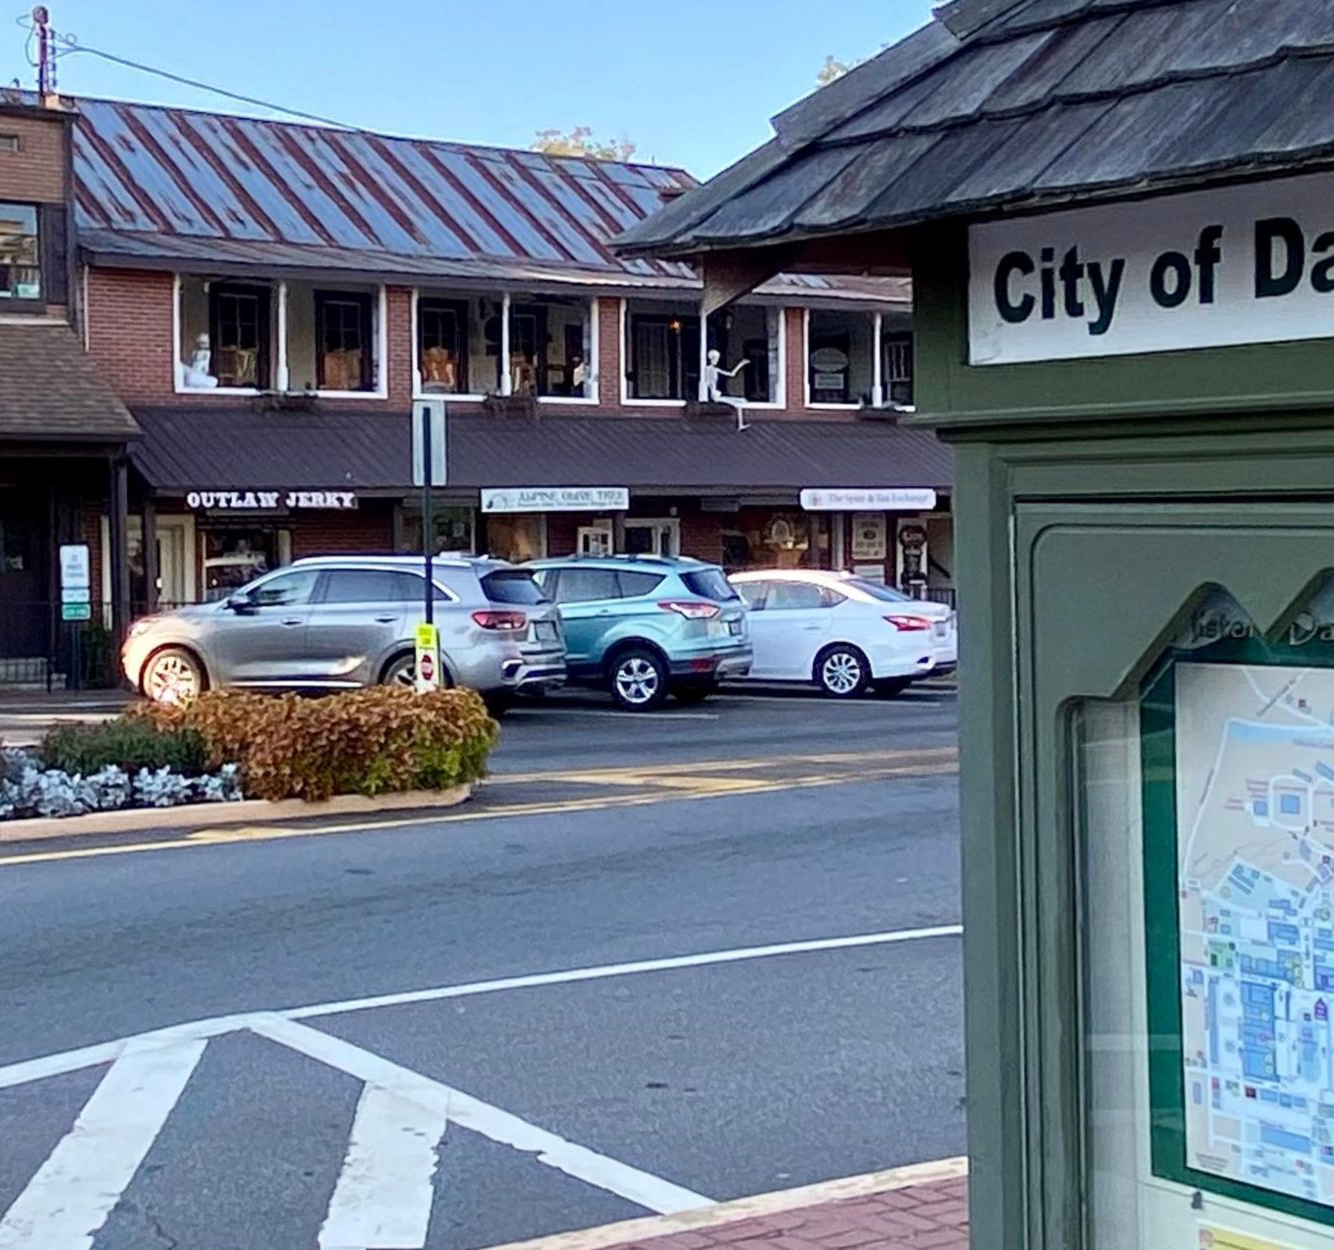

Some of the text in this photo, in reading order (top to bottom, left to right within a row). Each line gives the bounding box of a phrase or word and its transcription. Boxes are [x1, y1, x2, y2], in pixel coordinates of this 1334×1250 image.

[994, 243, 1126, 336] City
[1149, 225, 1224, 309] of
[186, 491, 356, 509] OUTLAW JERKY
